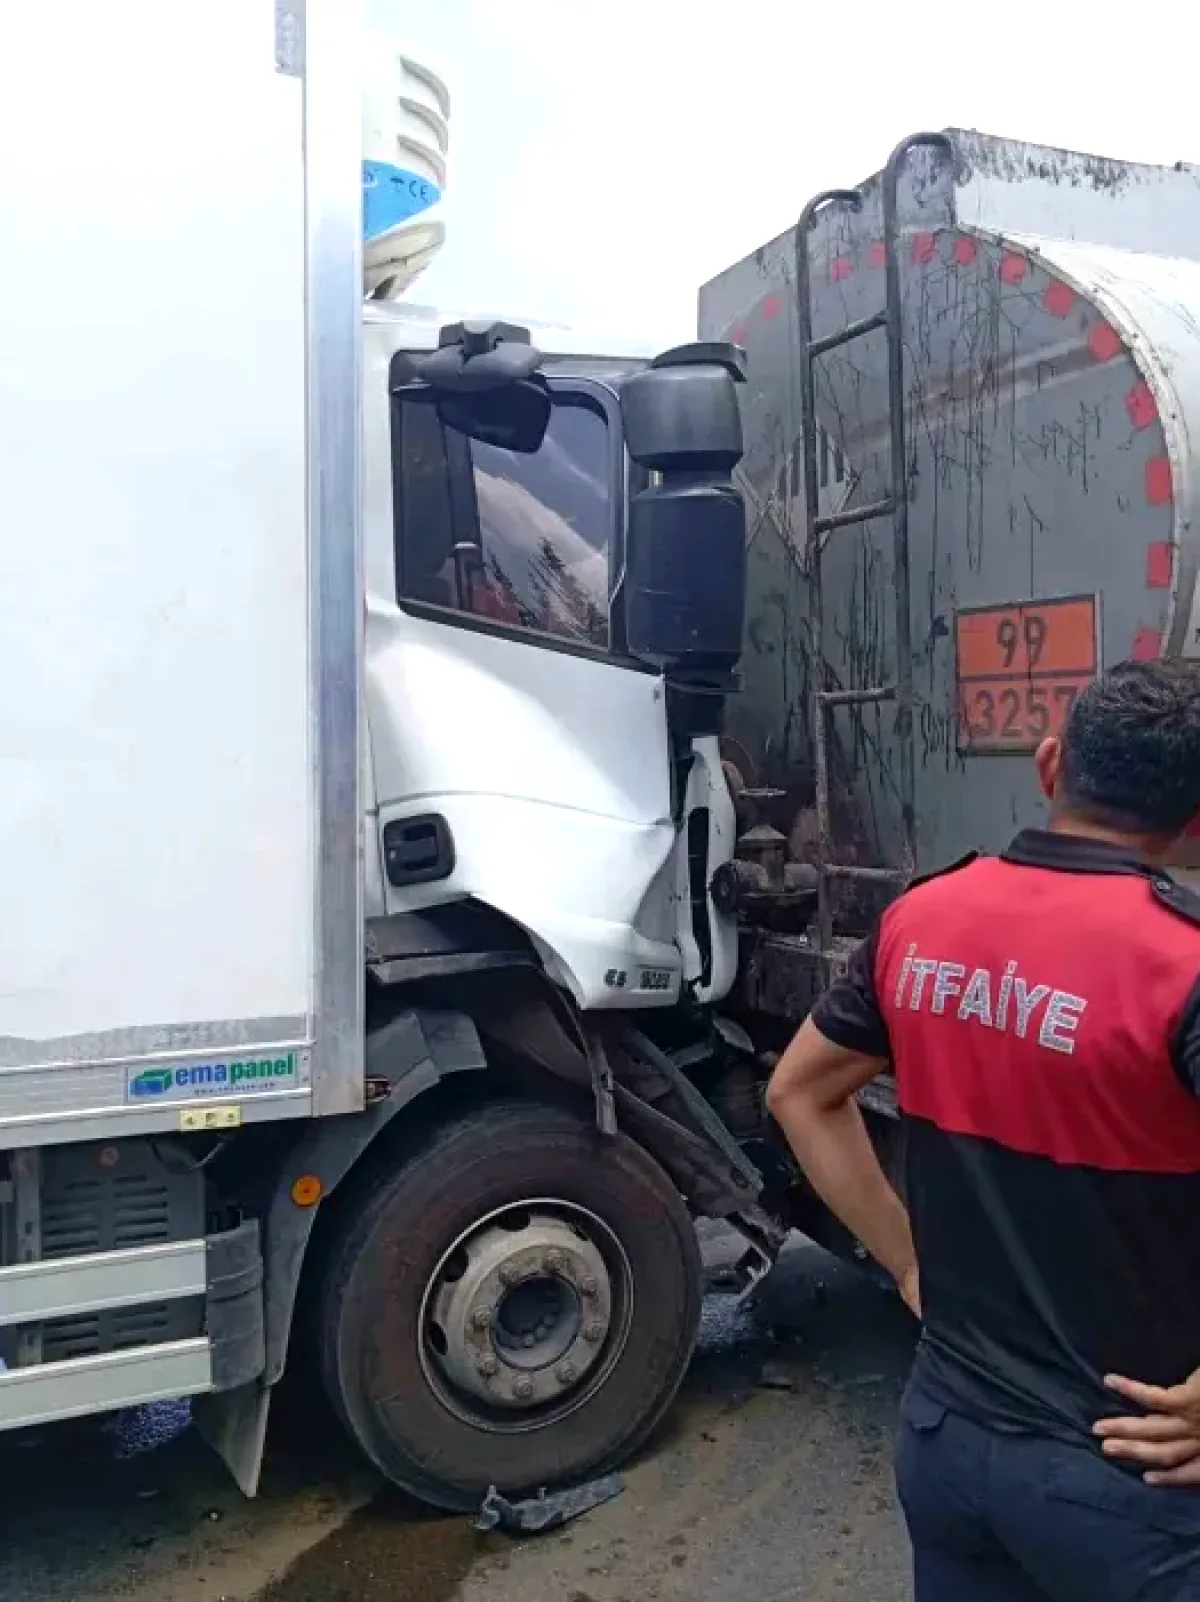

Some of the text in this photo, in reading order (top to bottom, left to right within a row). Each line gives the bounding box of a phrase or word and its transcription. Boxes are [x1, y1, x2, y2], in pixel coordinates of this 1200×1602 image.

[997, 616, 1045, 668] 99
[970, 685, 1079, 738] 3257
[895, 941, 1088, 1055] İTFAİYE
